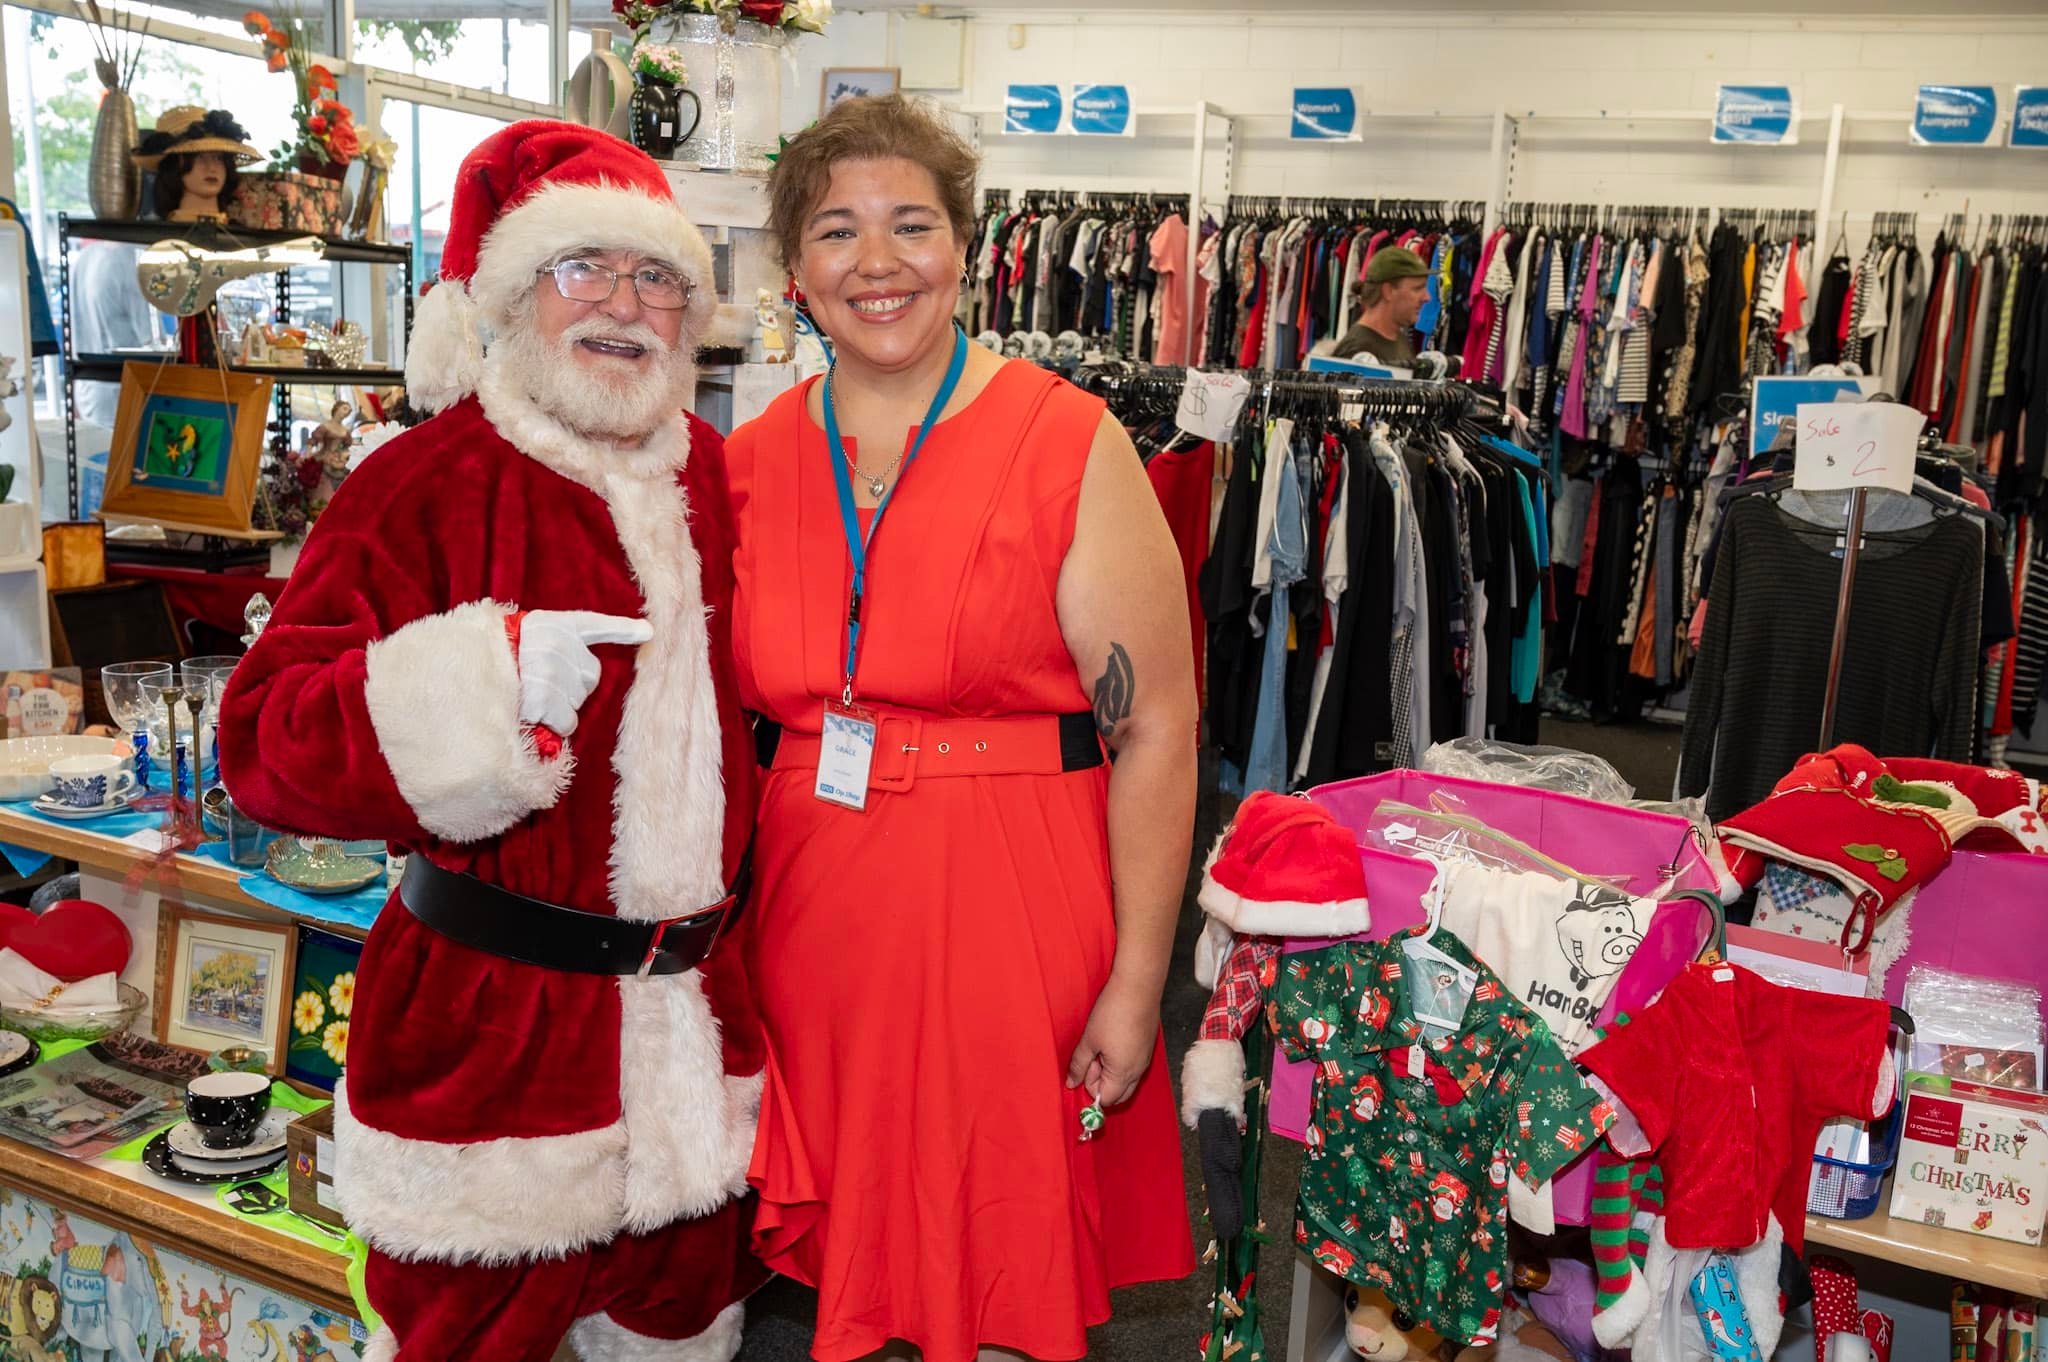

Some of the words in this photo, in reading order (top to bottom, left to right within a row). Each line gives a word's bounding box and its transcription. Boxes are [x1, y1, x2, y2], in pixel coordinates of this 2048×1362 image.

[1851, 440, 1887, 477] 2
[1958, 1126, 2028, 1160] ERRY
[1910, 1161, 2031, 1206] CHRISTMAS
